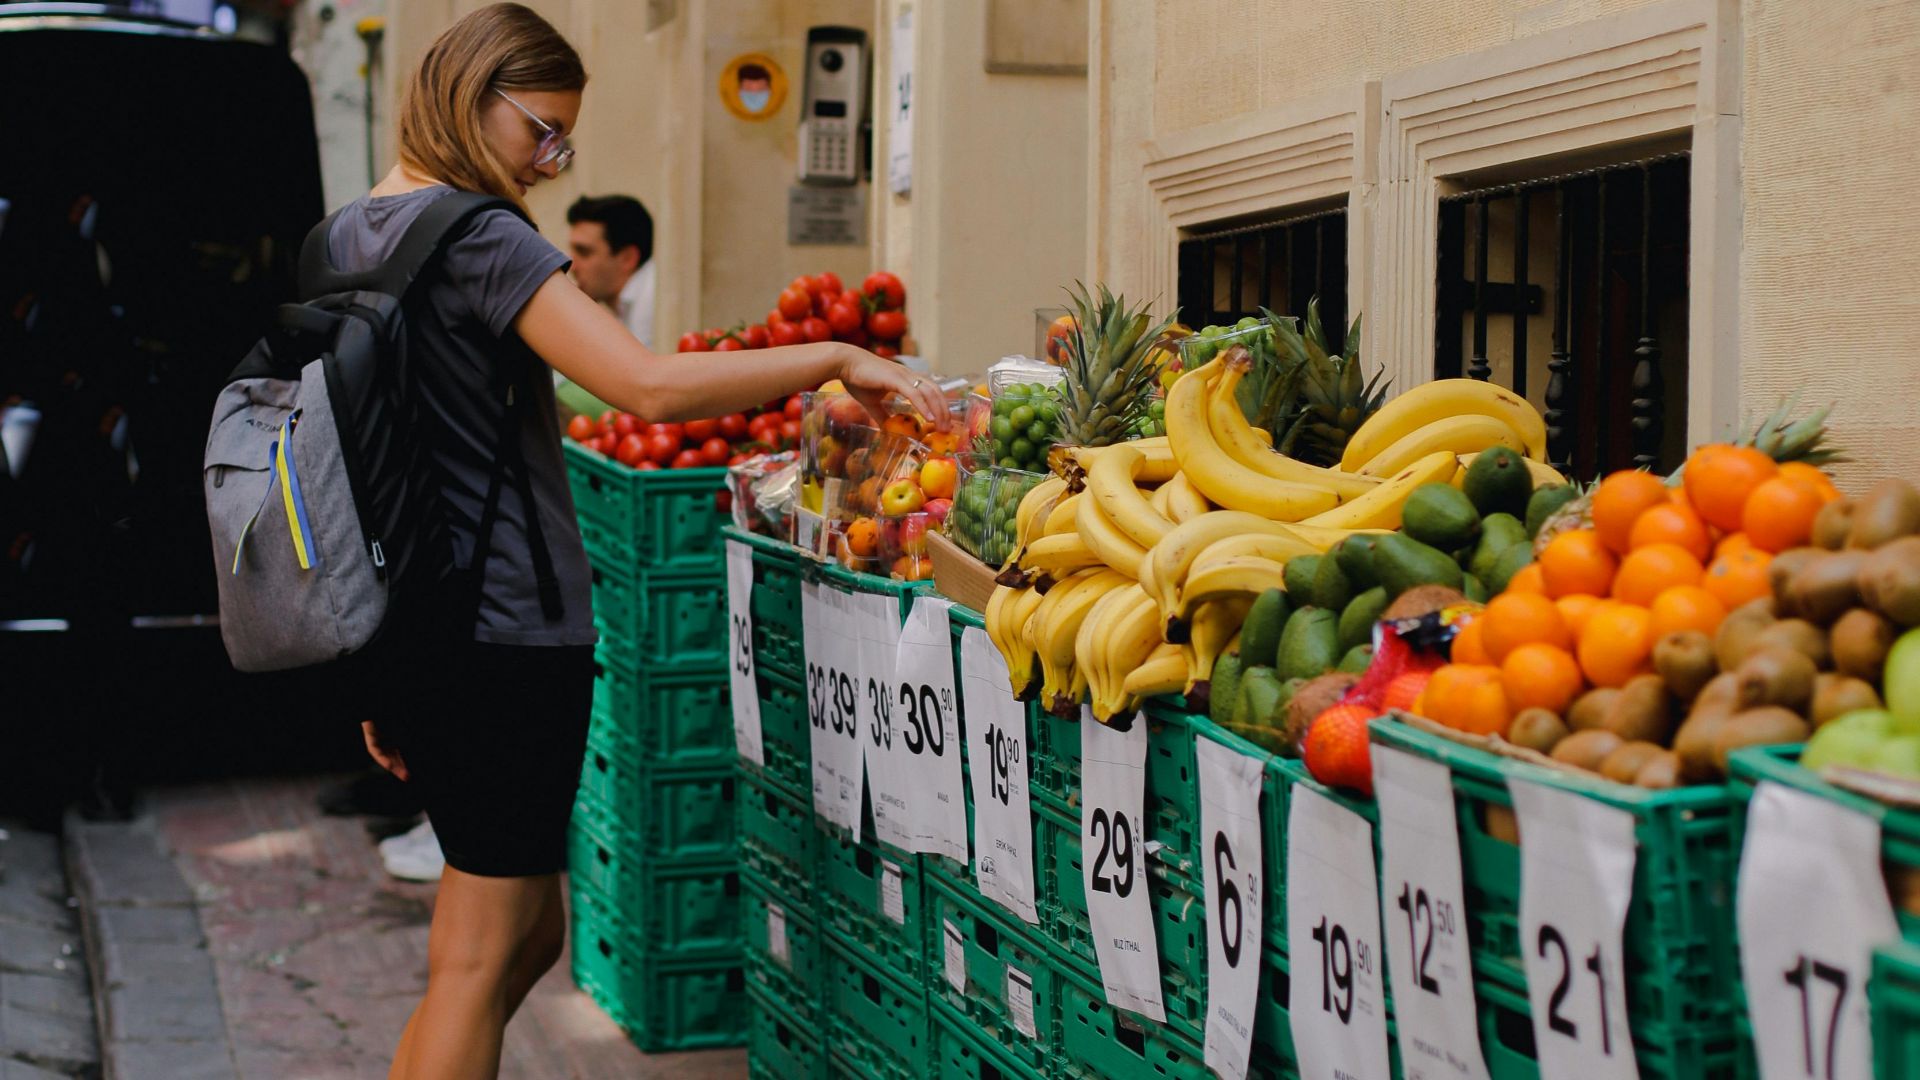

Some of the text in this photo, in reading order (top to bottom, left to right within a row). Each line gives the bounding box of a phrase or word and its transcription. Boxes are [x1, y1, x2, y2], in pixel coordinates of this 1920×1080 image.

[829, 666, 856, 740] 39
[868, 676, 891, 752] 39
[900, 682, 944, 757] 30
[985, 722, 1009, 806] 19
[1091, 807, 1133, 898] 29
[1214, 830, 1242, 968] 6
[1312, 914, 1353, 1026] 19
[1398, 881, 1440, 997] 12
[1538, 924, 1611, 1056] 21
[1784, 953, 1848, 1080] 17
